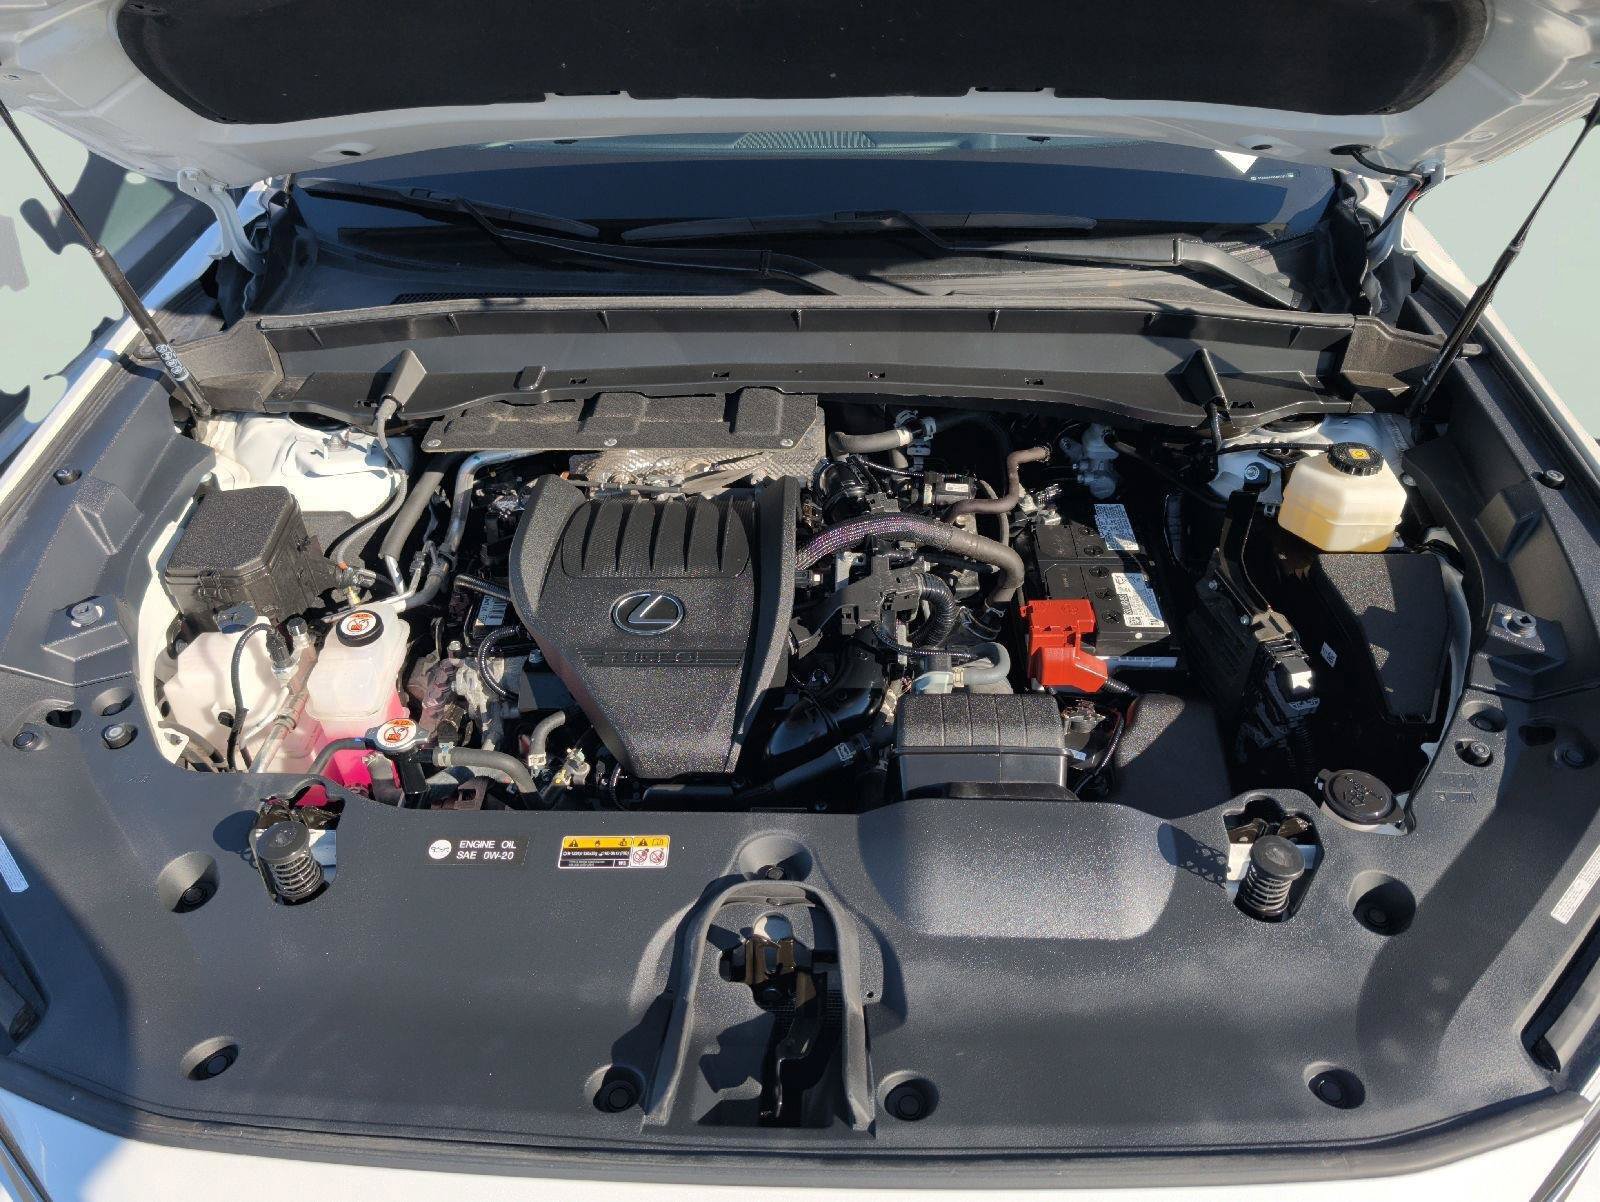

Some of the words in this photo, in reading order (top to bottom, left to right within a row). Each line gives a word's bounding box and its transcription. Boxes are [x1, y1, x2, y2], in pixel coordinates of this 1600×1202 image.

[459, 840, 496, 849] ENGINE
[501, 840, 517, 849] OIL
[456, 850, 477, 860] SAE
[483, 850, 514, 860] 0W-20
